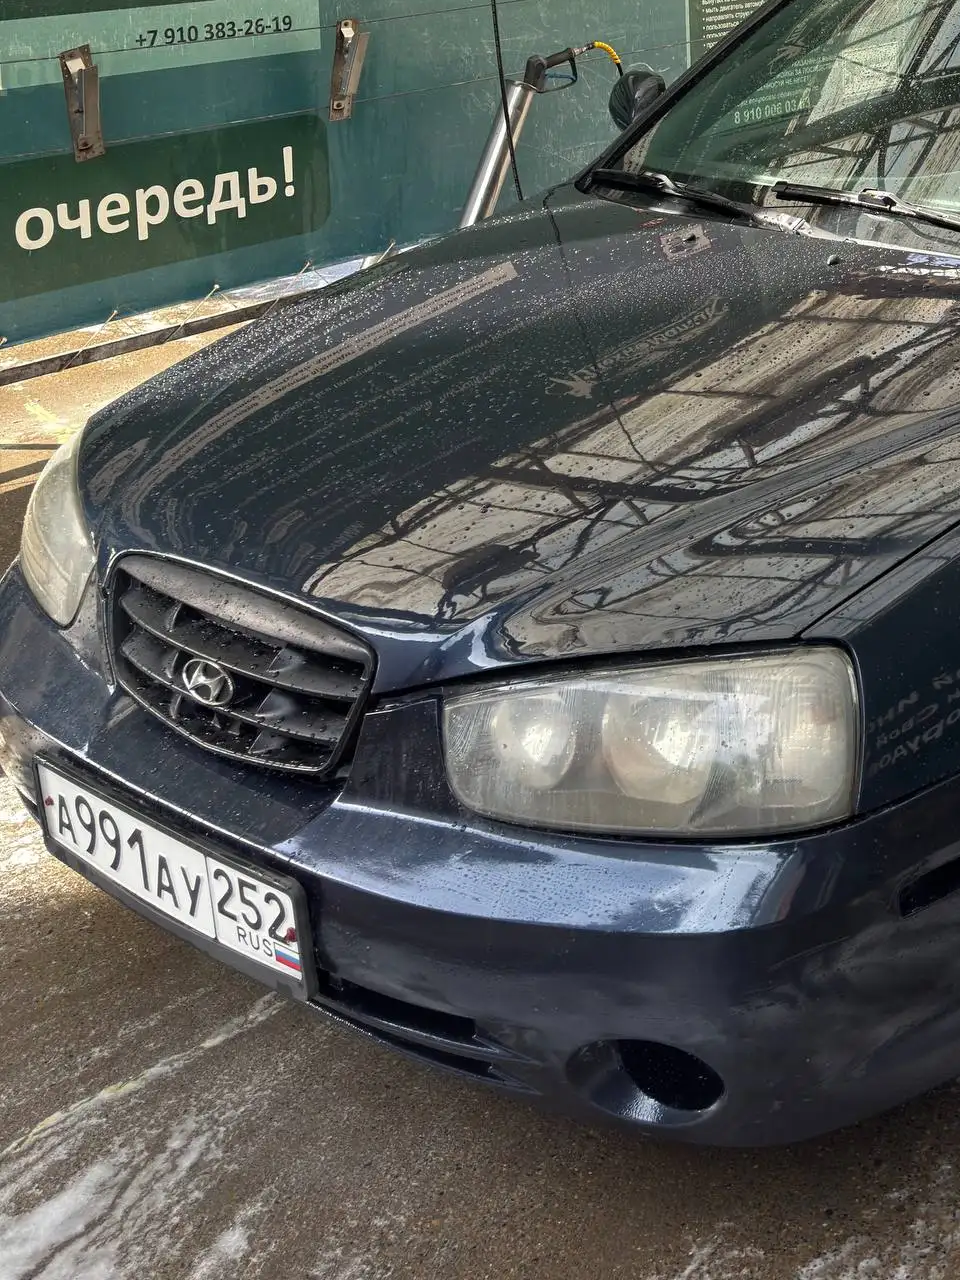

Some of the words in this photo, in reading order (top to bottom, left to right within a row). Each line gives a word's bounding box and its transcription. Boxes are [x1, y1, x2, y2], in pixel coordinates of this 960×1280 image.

[135, 30, 157, 48] +7
[164, 25, 199, 45] 910
[203, 15, 292, 42] 383-26-19
[734, 111, 741, 124] 8
[743, 106, 762, 122] 910
[15, 145, 296, 251] очередь!
[57, 794, 203, 918] А991АУ
[213, 866, 294, 943] 252
[237, 925, 275, 958] RUS
